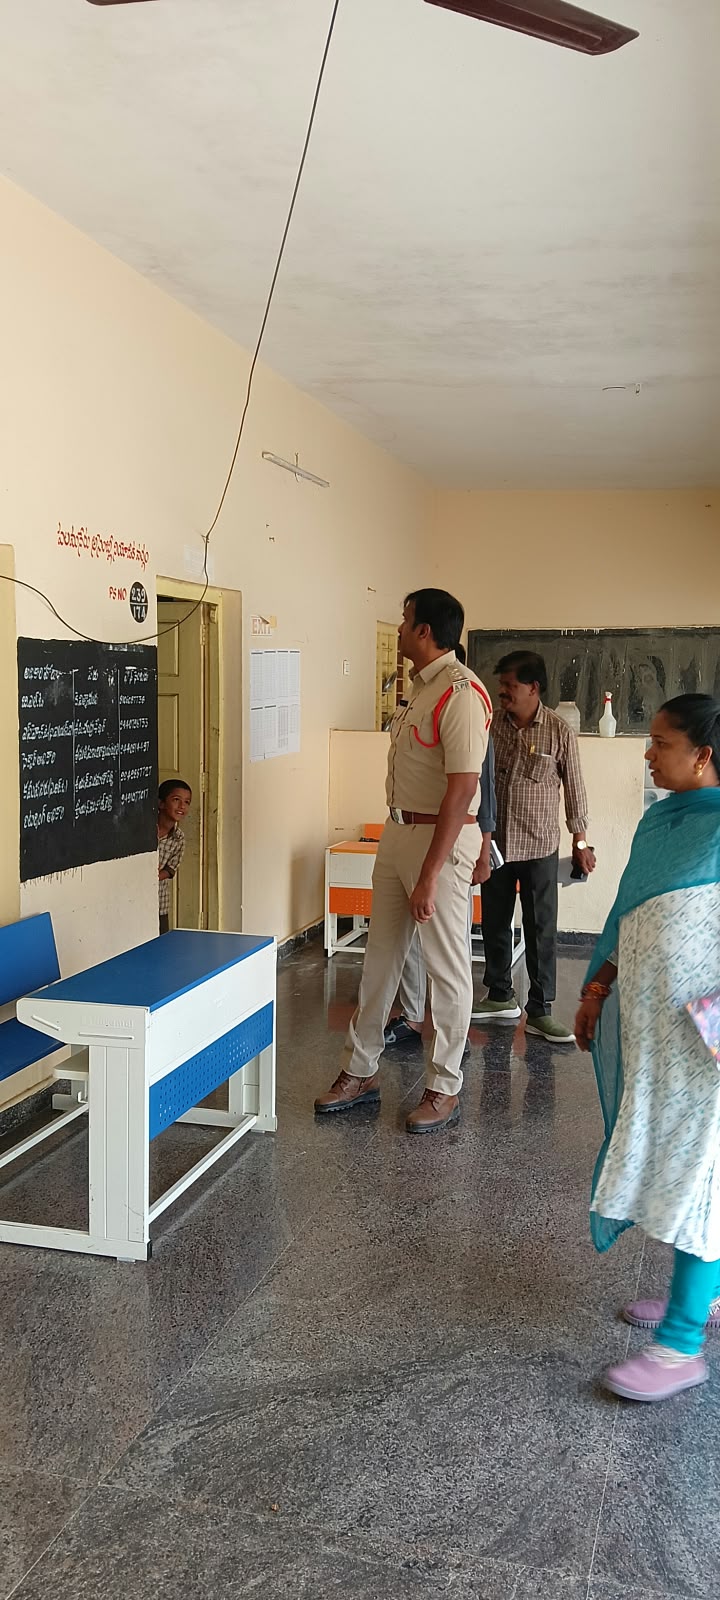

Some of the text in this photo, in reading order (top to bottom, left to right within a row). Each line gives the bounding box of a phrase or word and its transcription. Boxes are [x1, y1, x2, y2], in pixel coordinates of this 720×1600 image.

[109, 586, 127, 600] PS NO
[131, 587, 146, 602] 239
[133, 605, 146, 620] 174
